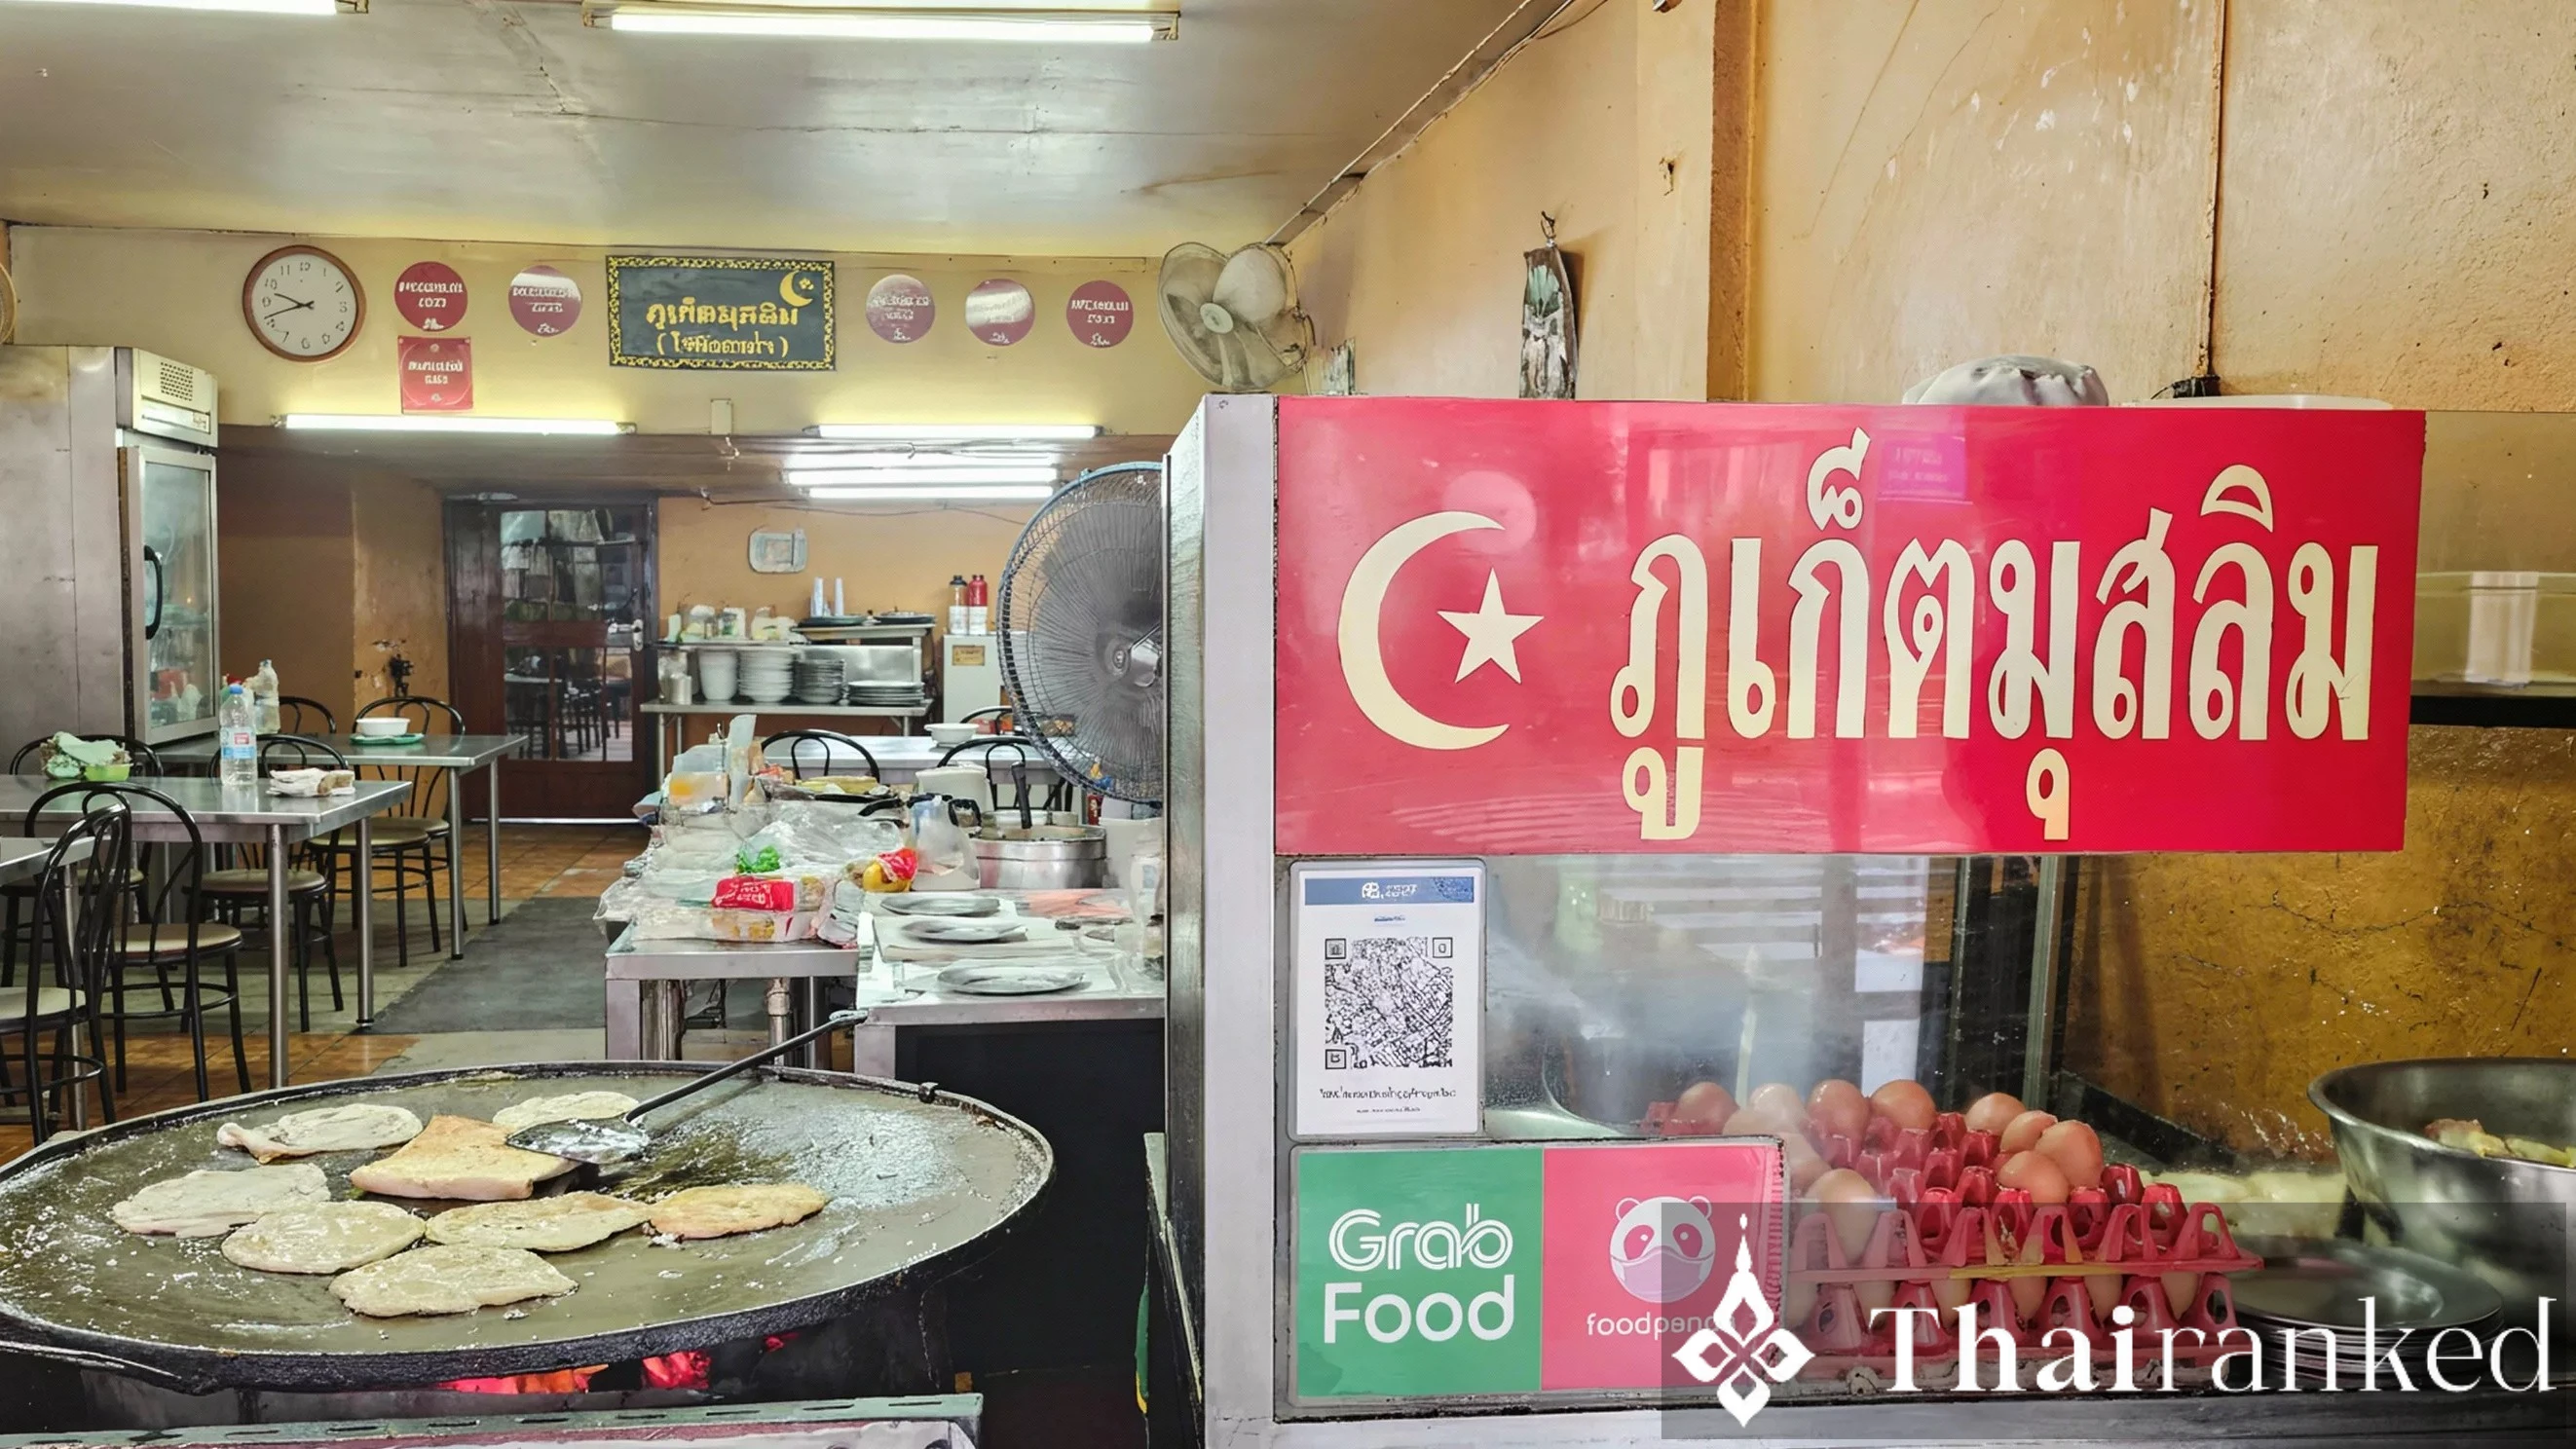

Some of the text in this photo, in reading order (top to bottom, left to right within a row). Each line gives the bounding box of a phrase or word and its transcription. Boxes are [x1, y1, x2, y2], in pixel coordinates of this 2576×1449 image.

[1609, 427, 2379, 842] ภูเก็ตมุสลิม
[1328, 1203, 1514, 1272] Grab
[1324, 1274, 1515, 1344] Food
[1587, 1311, 1735, 1340] foodpan
